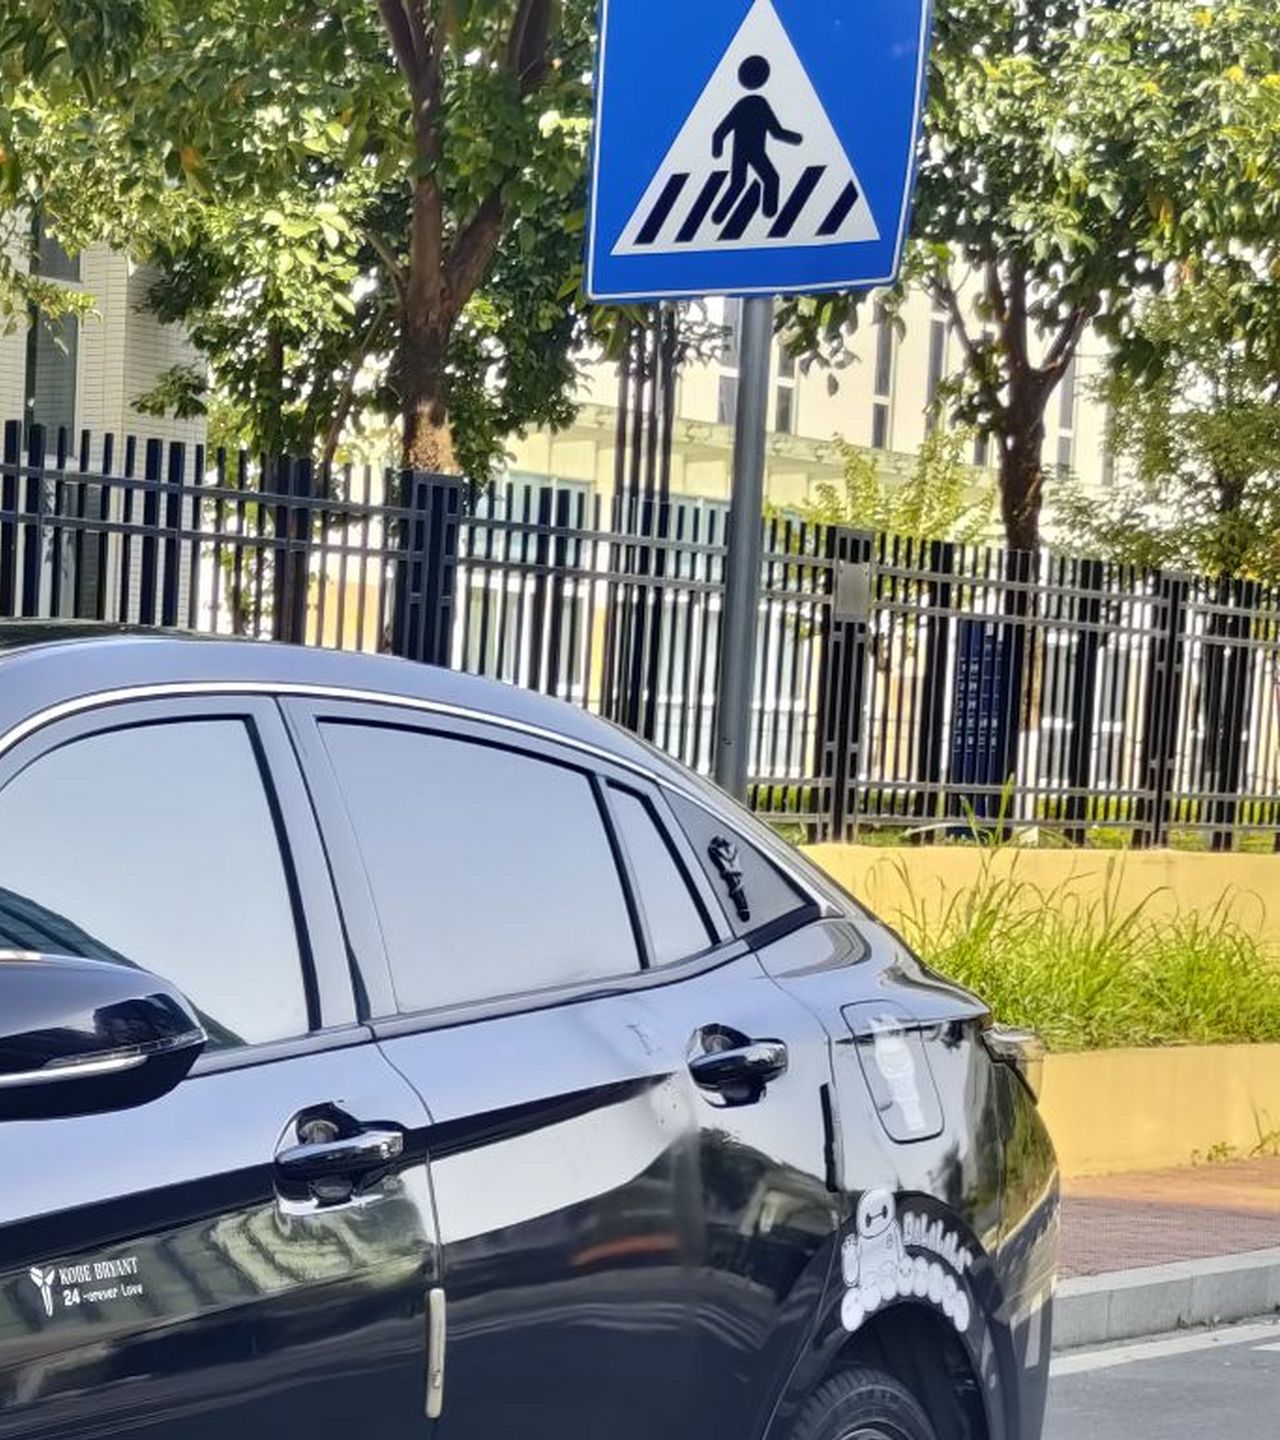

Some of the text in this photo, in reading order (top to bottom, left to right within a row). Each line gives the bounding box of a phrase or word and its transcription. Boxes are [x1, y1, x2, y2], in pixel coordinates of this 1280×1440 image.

[59, 1256, 139, 1286] KOBE BRYANT
[62, 1287, 81, 1306] 24
